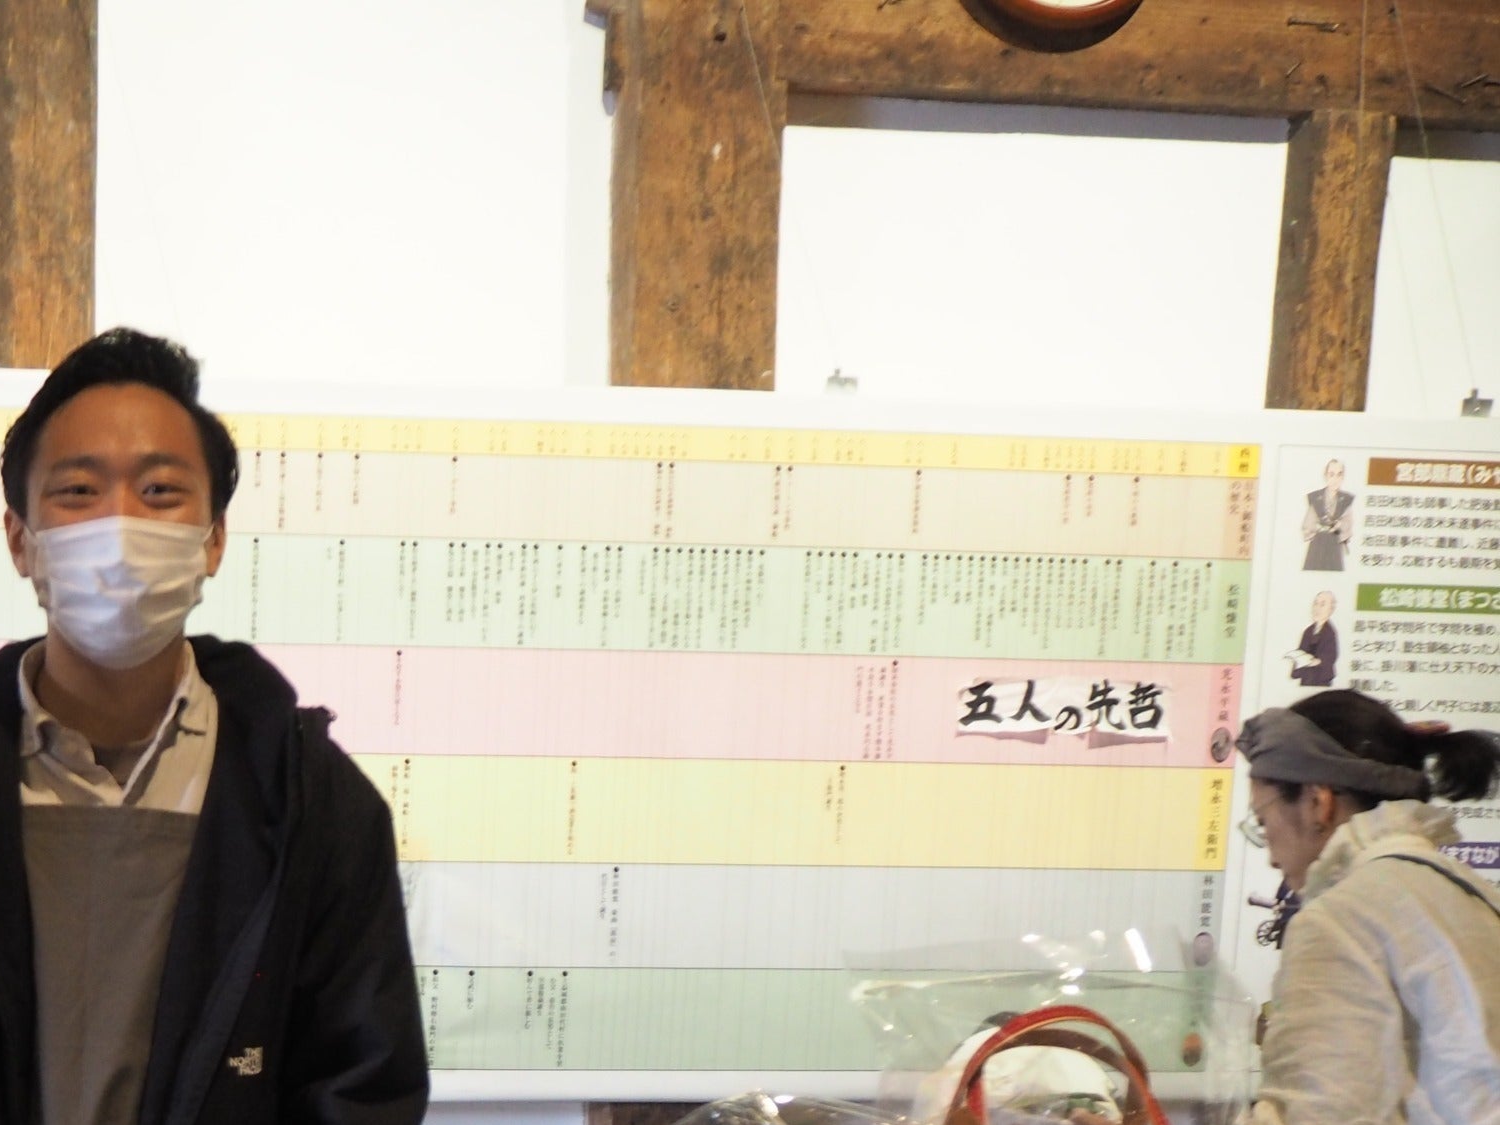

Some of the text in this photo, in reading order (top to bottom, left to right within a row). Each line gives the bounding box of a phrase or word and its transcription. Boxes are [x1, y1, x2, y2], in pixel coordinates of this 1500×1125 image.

[959, 679, 1164, 733] 五人の先哲
